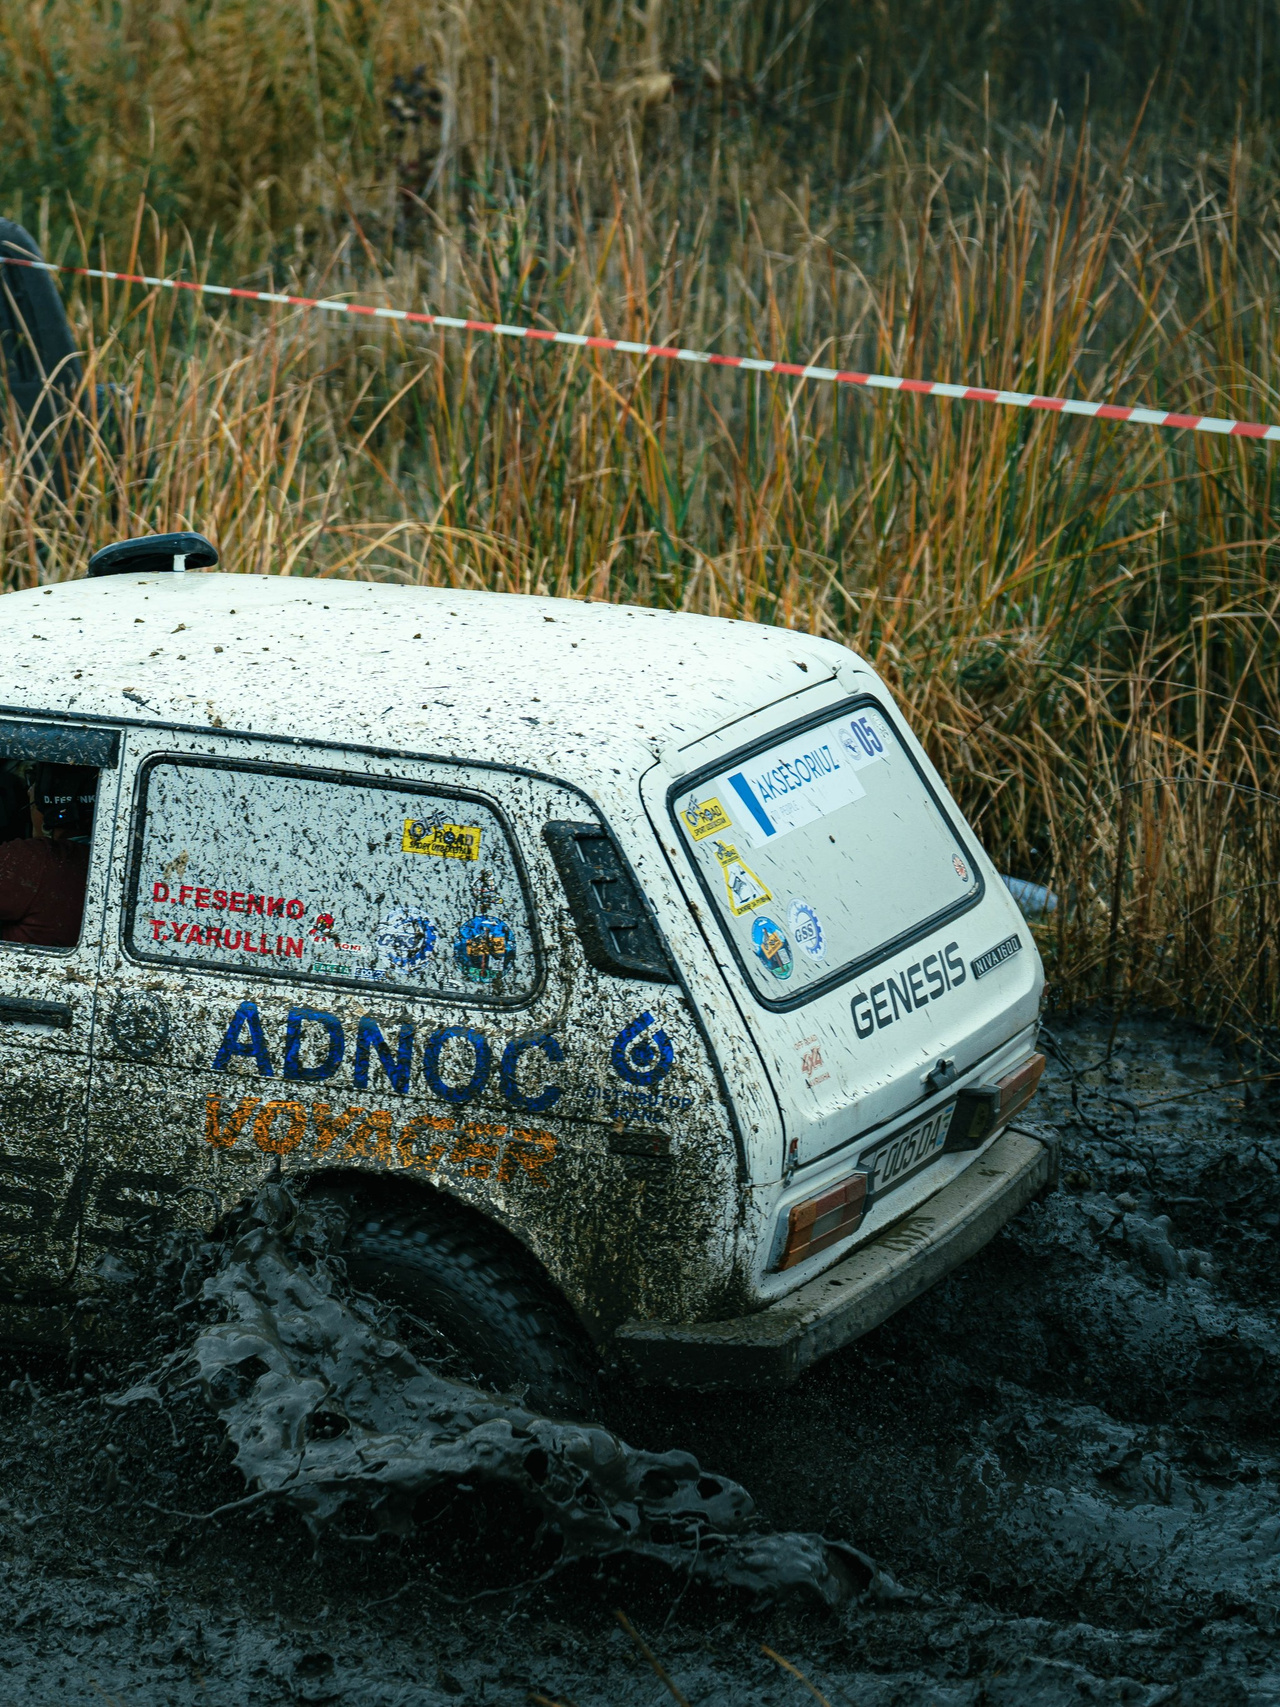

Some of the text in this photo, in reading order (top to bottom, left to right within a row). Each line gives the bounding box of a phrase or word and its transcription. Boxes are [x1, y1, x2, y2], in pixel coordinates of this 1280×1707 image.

[851, 717, 883, 757] 05
[756, 745, 840, 803] AKSESORIUZ
[700, 805, 723, 823] ROAD
[434, 829, 474, 847] ROAD
[153, 882, 305, 920] D.FESENKO
[150, 919, 304, 959] T.YARULLIN
[378, 933, 420, 949] GSS
[795, 923, 814, 942] GSS
[975, 937, 1019, 975] NIVA 1600
[850, 941, 967, 1040] GENESIS
[211, 1000, 565, 1112] ADNOC
